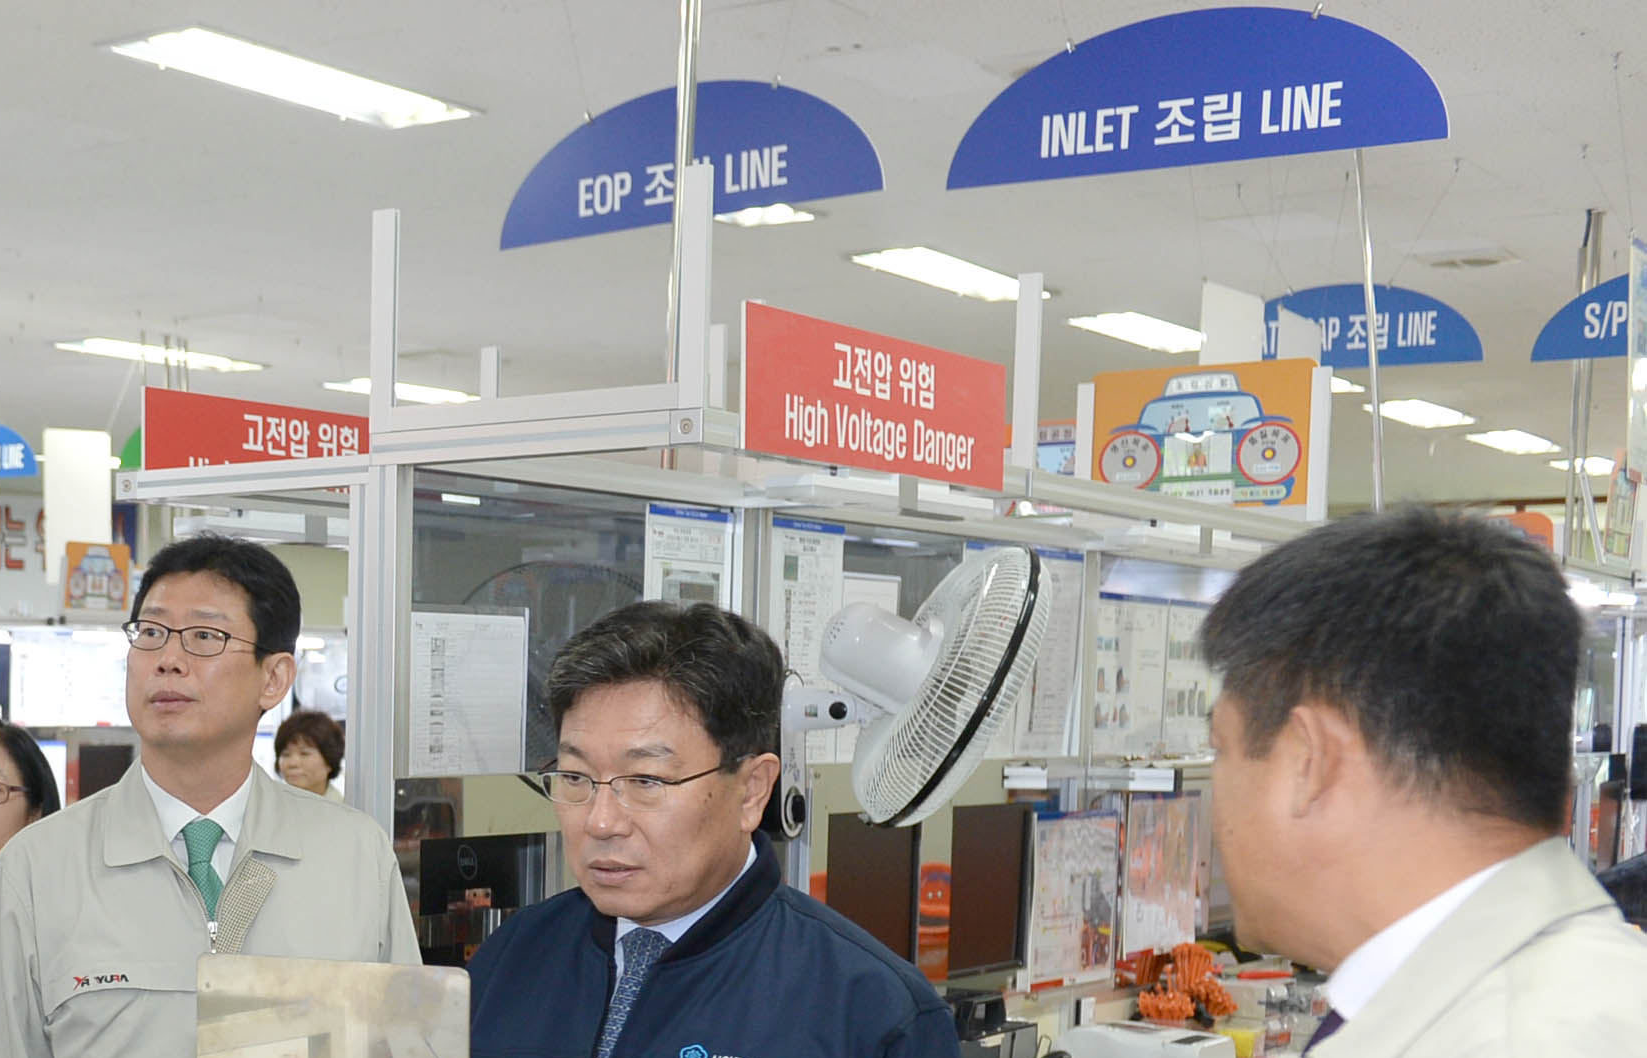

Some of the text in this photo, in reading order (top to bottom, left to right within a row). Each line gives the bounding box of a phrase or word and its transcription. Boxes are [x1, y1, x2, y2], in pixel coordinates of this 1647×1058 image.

[1040, 81, 1343, 159] INLET 조립 LINE
[578, 171, 632, 218] EOP
[725, 144, 788, 194] LINE
[1346, 313, 1389, 351] 조립
[1397, 311, 1437, 348] LINE
[832, 342, 936, 410] 고전압 위험
[242, 414, 359, 458] 고전압 위험
[785, 393, 975, 472] High Voltage Danger
[94, 973, 129, 985] YURA
